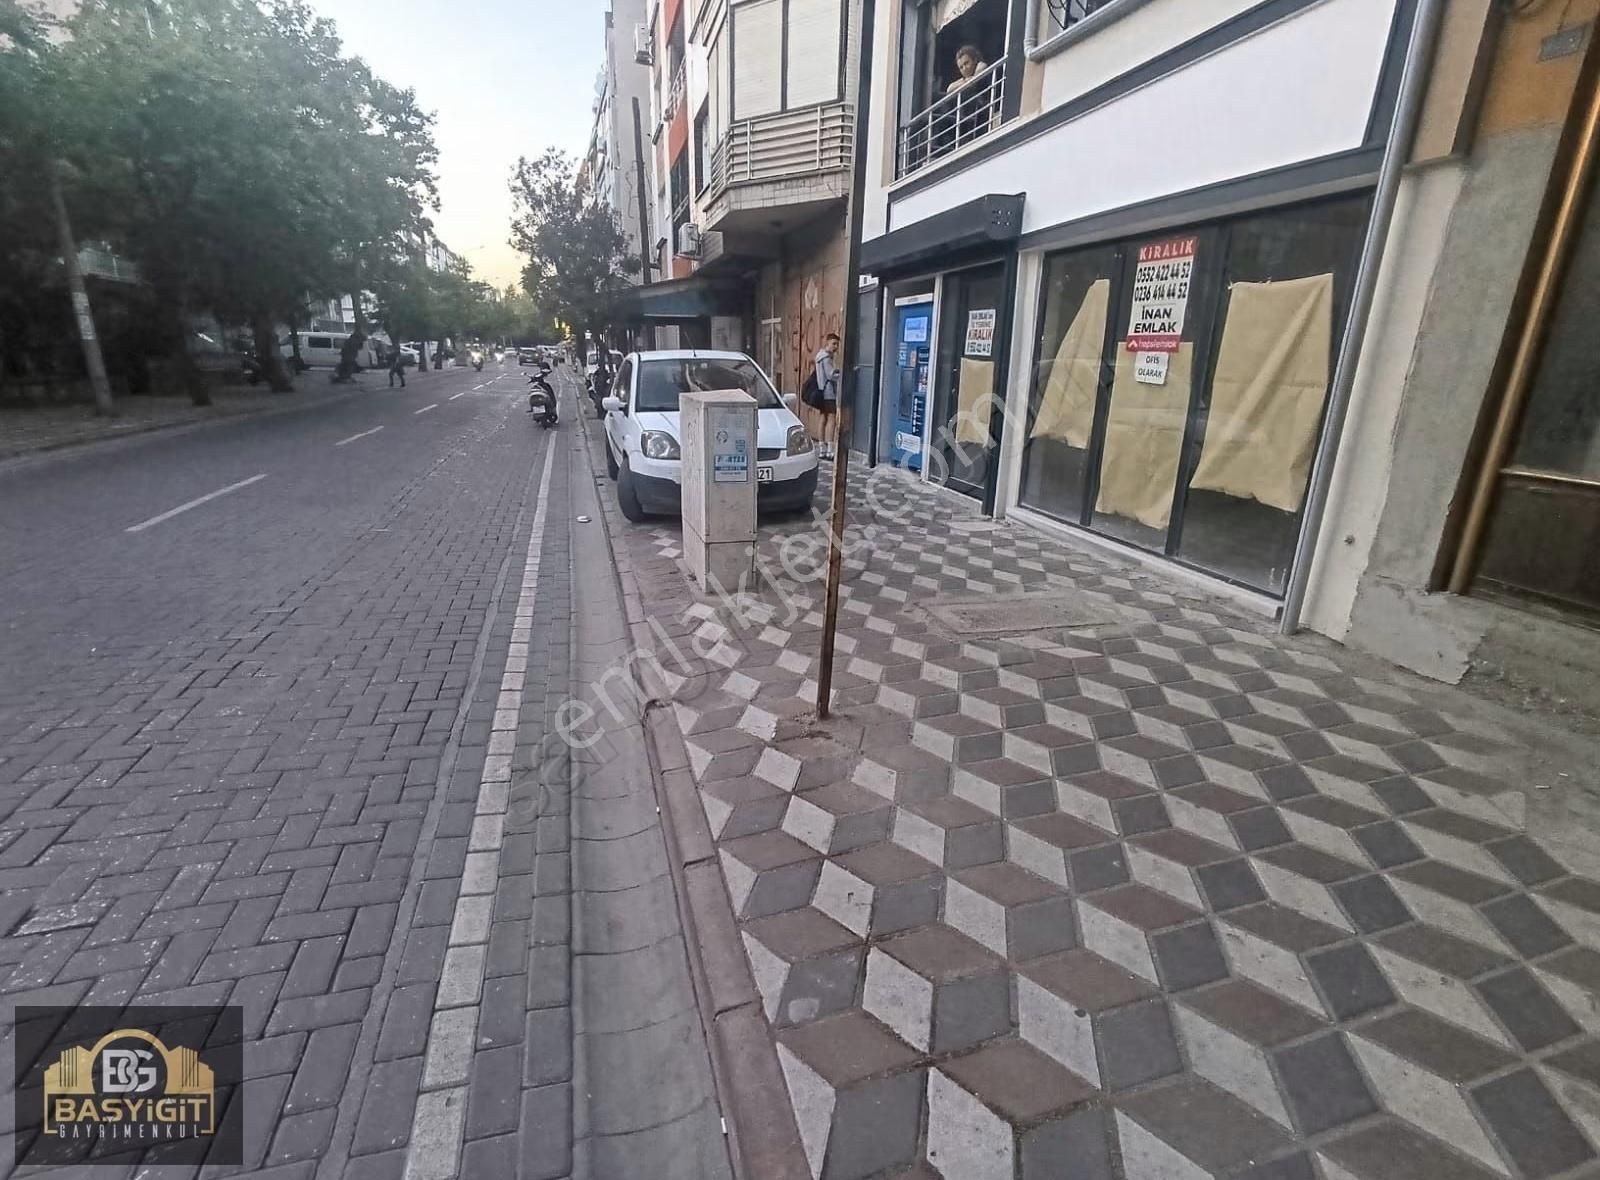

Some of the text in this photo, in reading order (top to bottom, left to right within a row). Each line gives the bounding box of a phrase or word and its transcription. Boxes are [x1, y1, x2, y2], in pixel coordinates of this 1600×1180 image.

[1137, 261, 1191, 283] 0552 422 44 52
[1134, 281, 1187, 302] 0236 414 44 52
[1141, 305, 1173, 320] İNAN
[1133, 321, 1177, 334] EMLAK
